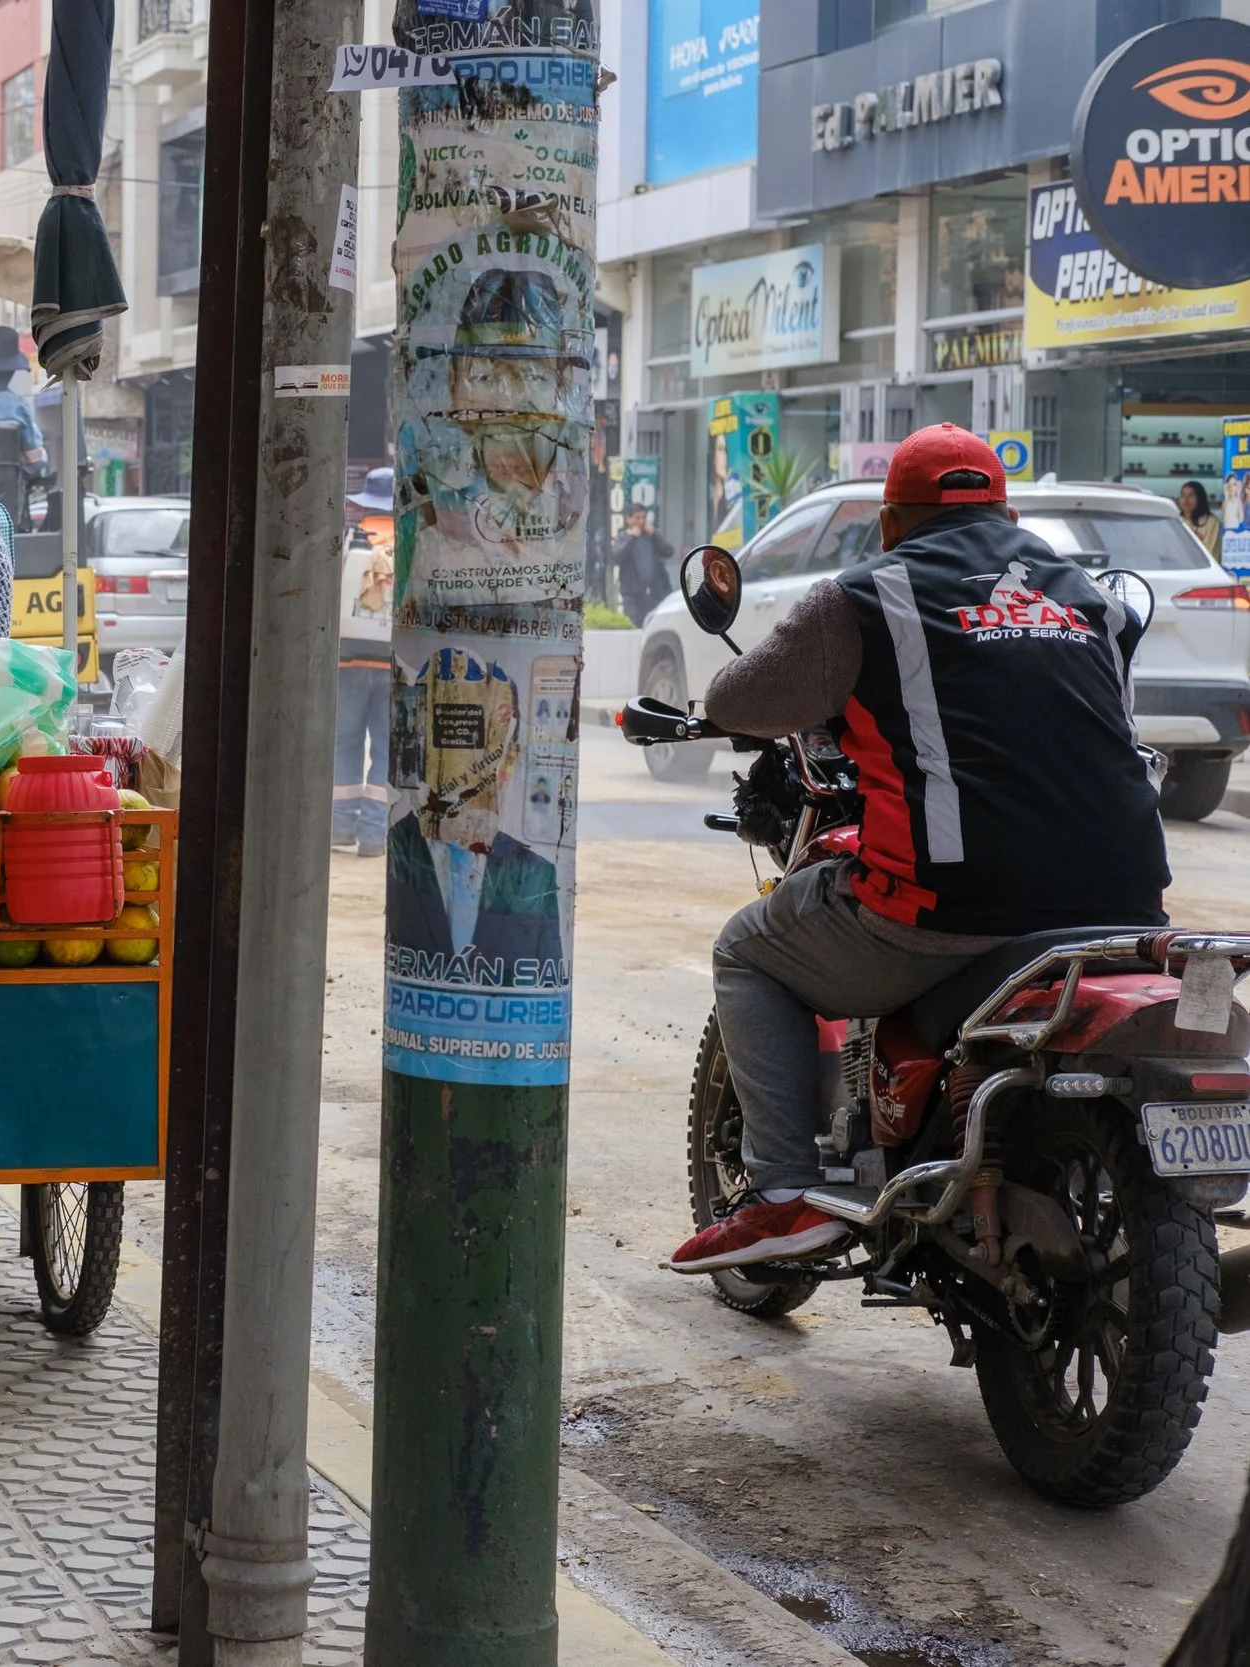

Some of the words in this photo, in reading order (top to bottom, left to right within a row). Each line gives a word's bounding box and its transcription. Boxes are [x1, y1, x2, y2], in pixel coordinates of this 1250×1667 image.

[854, 57, 1003, 142] PALMIER
[478, 577, 524, 589] VERDE
[424, 611, 499, 633] JUSTICIA
[502, 617, 550, 637] LIBRE
[957, 603, 1092, 632] IDEAL
[976, 628, 1024, 643] MOTO
[1029, 628, 1088, 644] SERVICE
[390, 986, 478, 1022] PARDO
[484, 999, 563, 1025] URIBE
[429, 1036, 511, 1059] SUPREMO
[515, 1041, 535, 1059] DE
[1177, 1105, 1243, 1120] BOLIVIA
